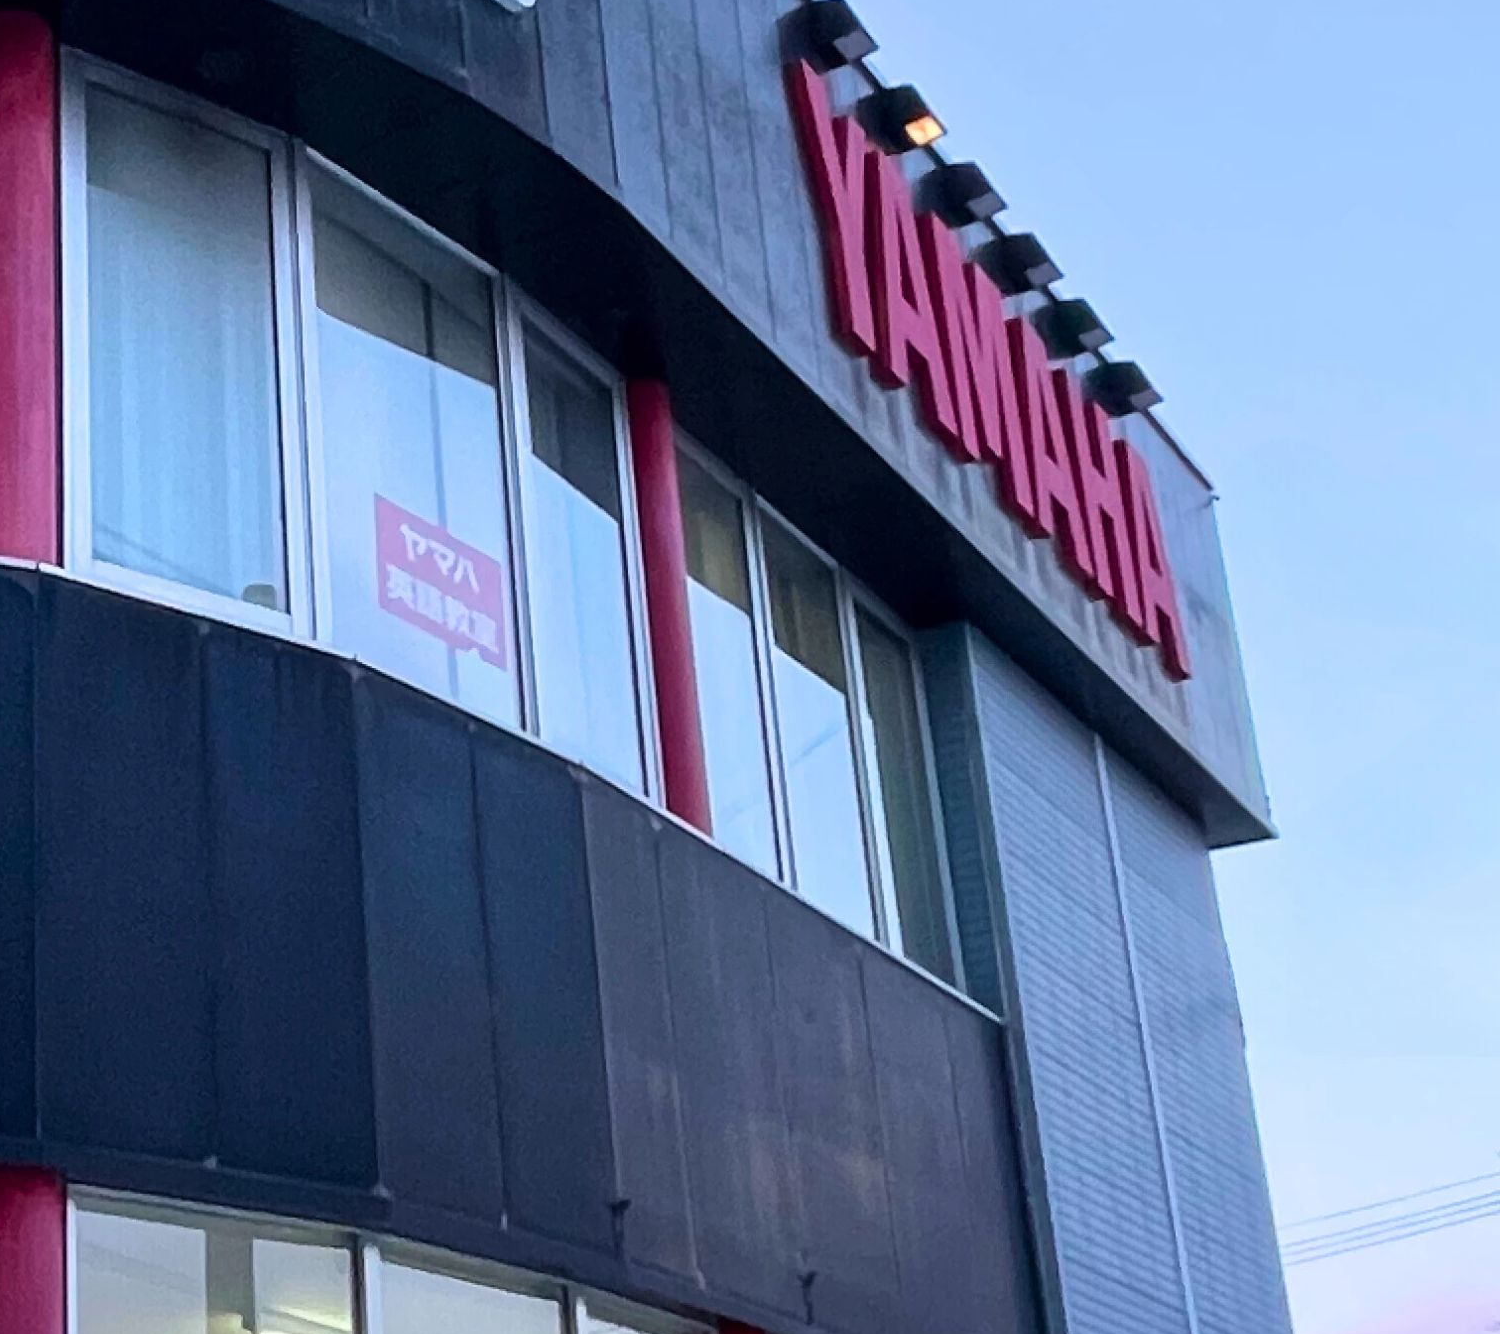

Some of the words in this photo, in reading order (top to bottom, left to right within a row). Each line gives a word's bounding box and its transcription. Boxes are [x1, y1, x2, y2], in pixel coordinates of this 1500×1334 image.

[785, 57, 1191, 682] YAMAHA
[399, 522, 481, 595] ヤマハ
